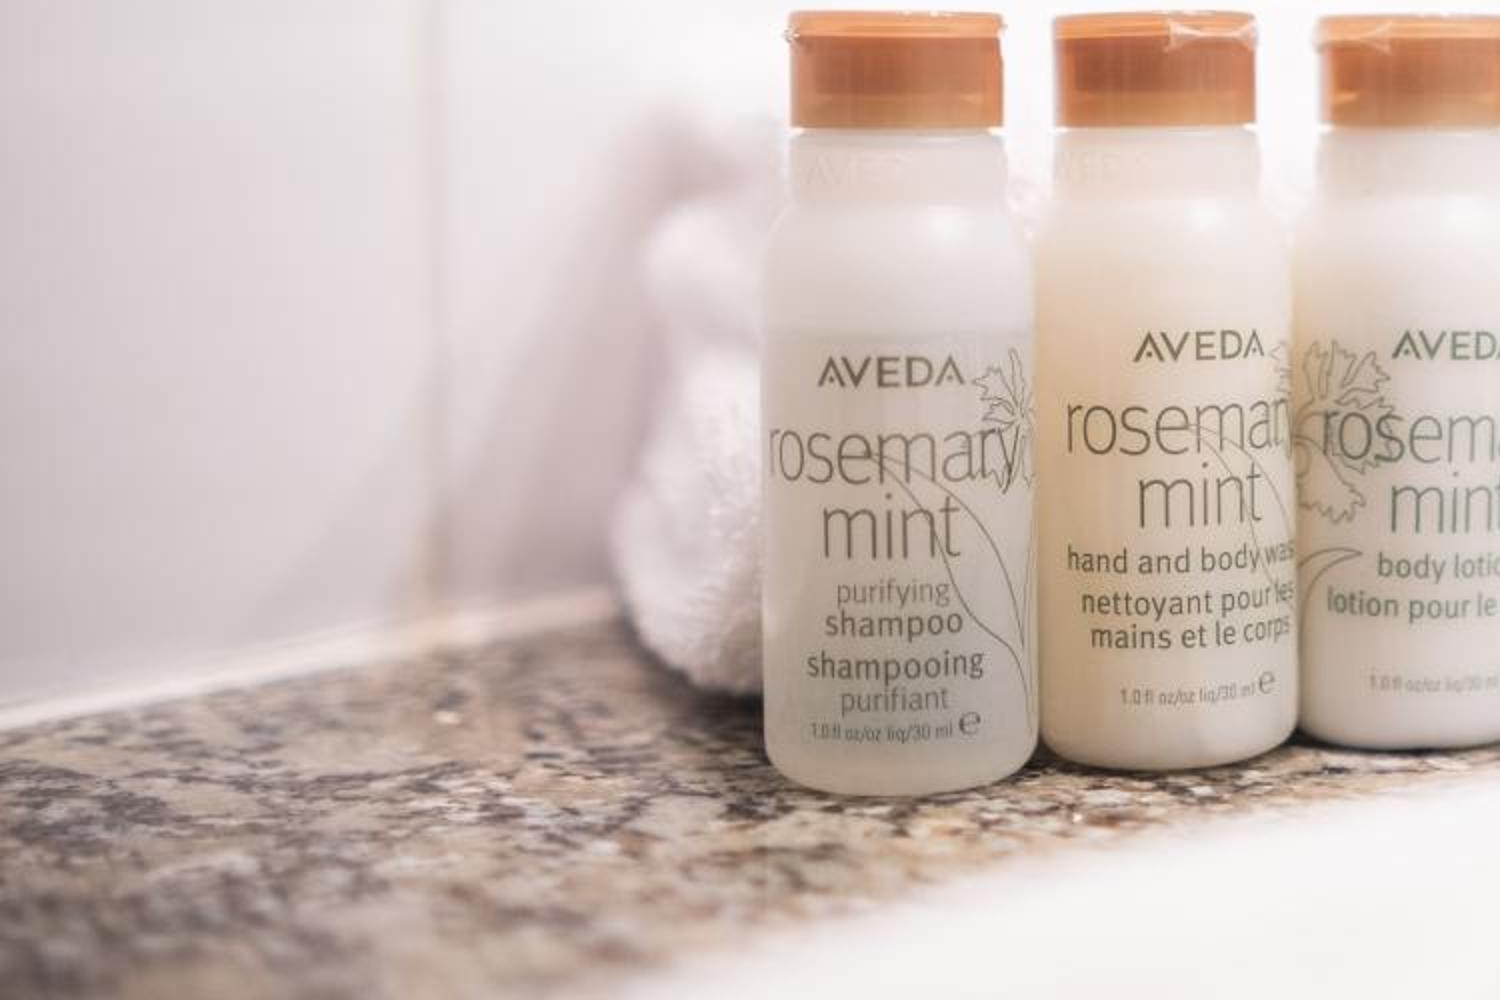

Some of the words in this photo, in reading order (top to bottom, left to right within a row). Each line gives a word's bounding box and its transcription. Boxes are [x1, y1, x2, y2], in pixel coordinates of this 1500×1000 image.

[1133, 329, 1265, 362] AVEDA
[818, 355, 965, 388] AVEDA
[769, 425, 1019, 494] rosemary
[1139, 461, 1262, 528] mint
[823, 492, 961, 559] mint
[1067, 544, 1128, 574] hand
[1138, 547, 1191, 575] and
[1201, 543, 1261, 574] body
[1377, 552, 1446, 585] body
[836, 579, 950, 608] purifying
[1081, 592, 1213, 622] nettoyant
[1221, 584, 1271, 618] pour
[1327, 585, 1399, 617] lotion
[1408, 597, 1471, 625] pour
[1477, 592, 1497, 616] le
[825, 608, 963, 643] shampoo
[1091, 624, 1171, 649] mains
[1181, 625, 1207, 648] et
[1215, 620, 1236, 646] le
[1243, 615, 1290, 645] corps
[807, 649, 984, 685] shampooing
[840, 686, 949, 718] purifiant
